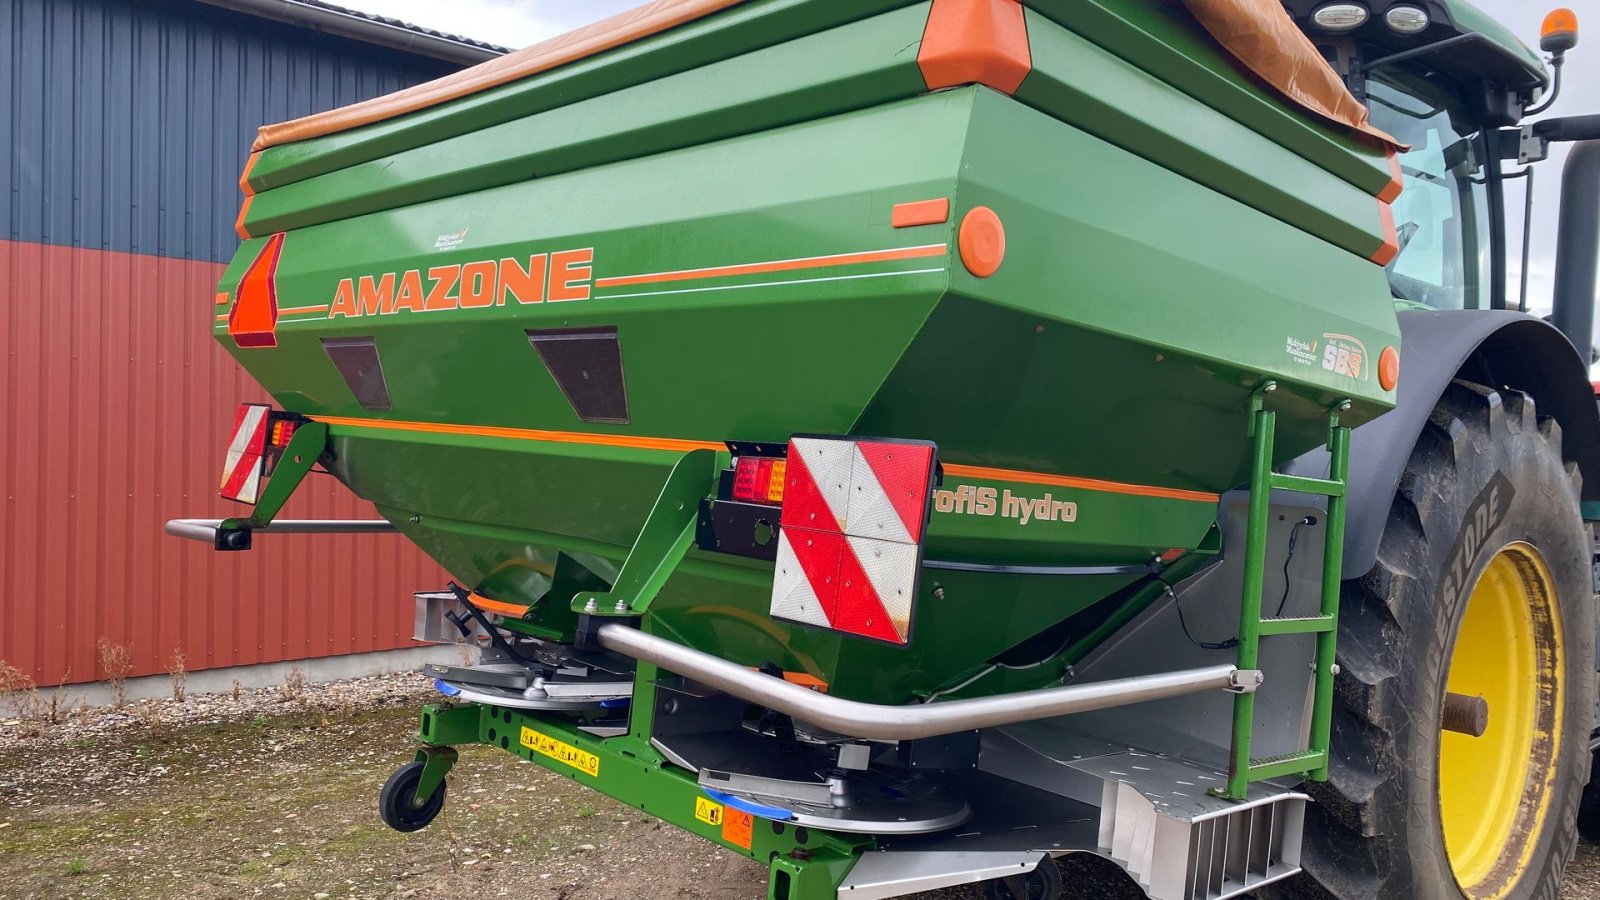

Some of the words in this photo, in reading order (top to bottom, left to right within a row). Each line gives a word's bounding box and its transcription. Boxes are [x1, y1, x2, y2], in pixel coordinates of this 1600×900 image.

[328, 247, 594, 319] AMAZONE
[1322, 344, 1362, 378] SBS
[1001, 489, 1077, 525] hydro
